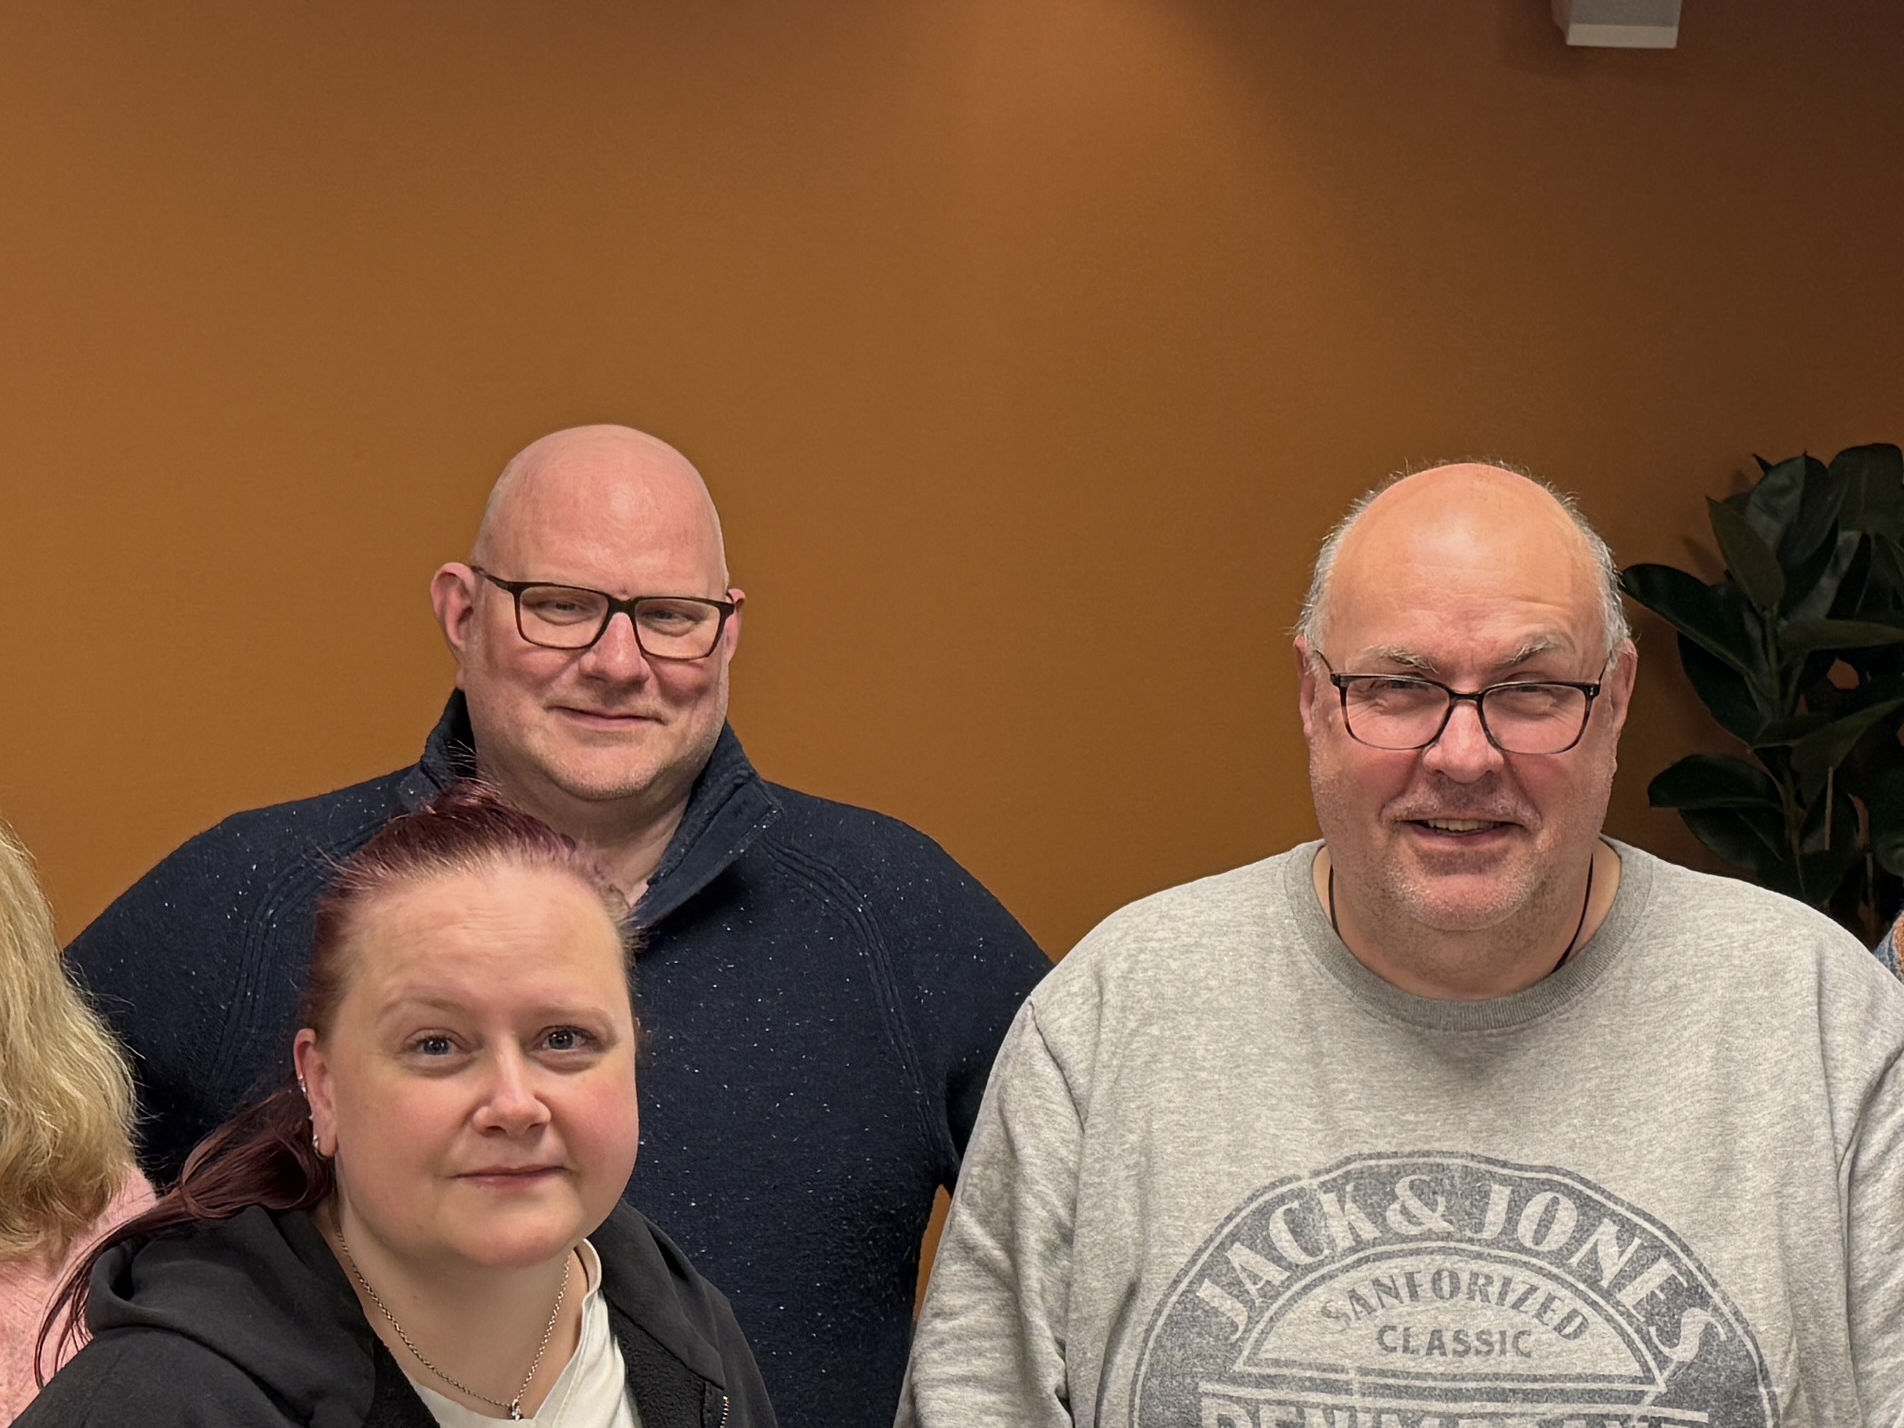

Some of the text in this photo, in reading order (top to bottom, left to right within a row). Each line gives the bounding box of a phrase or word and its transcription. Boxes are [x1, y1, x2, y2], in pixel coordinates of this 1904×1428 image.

[1195, 1173, 1729, 1366] JACK & JONES
[1319, 1268, 1591, 1342] SANFORIZED
[1375, 1324, 1532, 1359] CLASSIC
